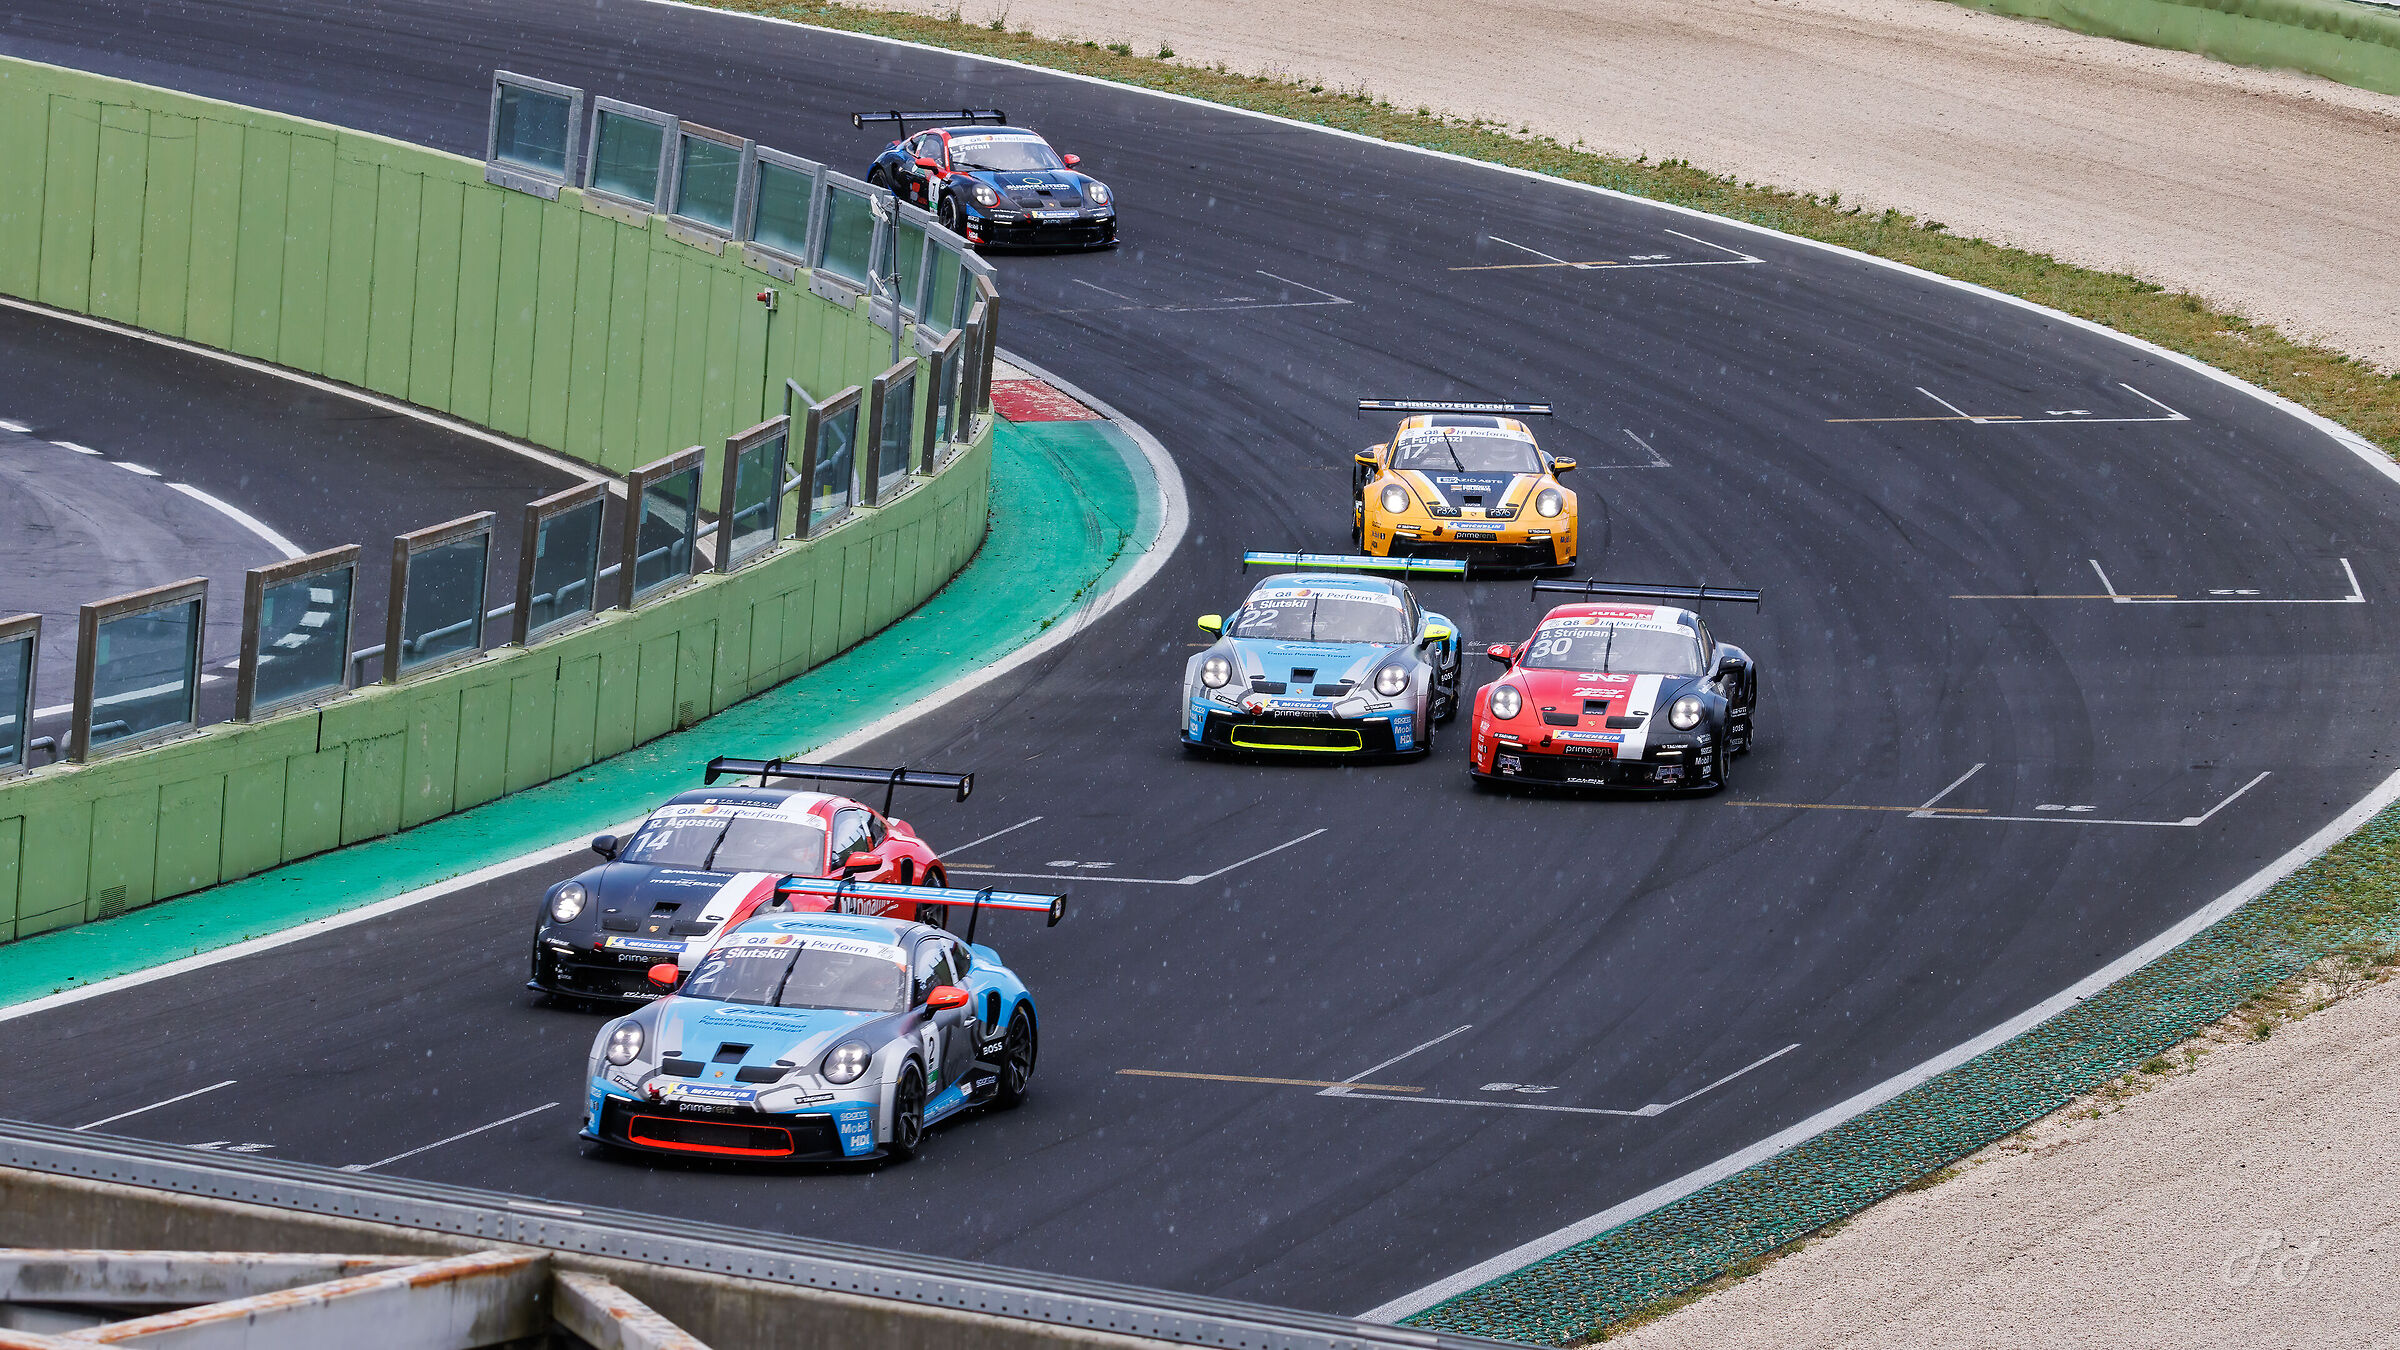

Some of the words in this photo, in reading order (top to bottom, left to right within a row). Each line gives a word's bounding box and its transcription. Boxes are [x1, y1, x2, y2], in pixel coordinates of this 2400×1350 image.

[959, 143, 991, 152] Ferrari
[1470, 430, 1510, 438] Perform
[1411, 436, 1464, 446] Fulgenzi
[1399, 443, 1428, 460] 17
[1456, 532, 1496, 540] primerent
[1323, 593, 1373, 602] Perform
[1238, 610, 1280, 629] 22
[1562, 619, 1581, 627] Q8
[1615, 621, 1663, 631] Perform
[1540, 630, 1552, 641] B.
[1554, 628, 1618, 639] Strignano
[1531, 637, 1573, 659] 30
[1281, 702, 1329, 710] MICHELIN
[1274, 710, 1320, 719] primerent
[1573, 733, 1621, 741] MICHELIN
[1565, 744, 1612, 755] primerent
[737, 808, 789, 821] Perform
[647, 818, 664, 830] R.
[664, 816, 729, 830] Agostin
[634, 830, 674, 854] 14
[627, 940, 684, 951] MICHELIN
[747, 936, 769, 946] Q8
[811, 939, 870, 955] Perform
[617, 953, 670, 964] primerent
[693, 960, 727, 985] 2
[982, 1041, 1004, 1056] BOSS
[689, 1088, 753, 1099] MICHELIN
[679, 1102, 736, 1115] primerent
[840, 1120, 869, 1134] Mobil
[850, 1133, 870, 1148] HDI
